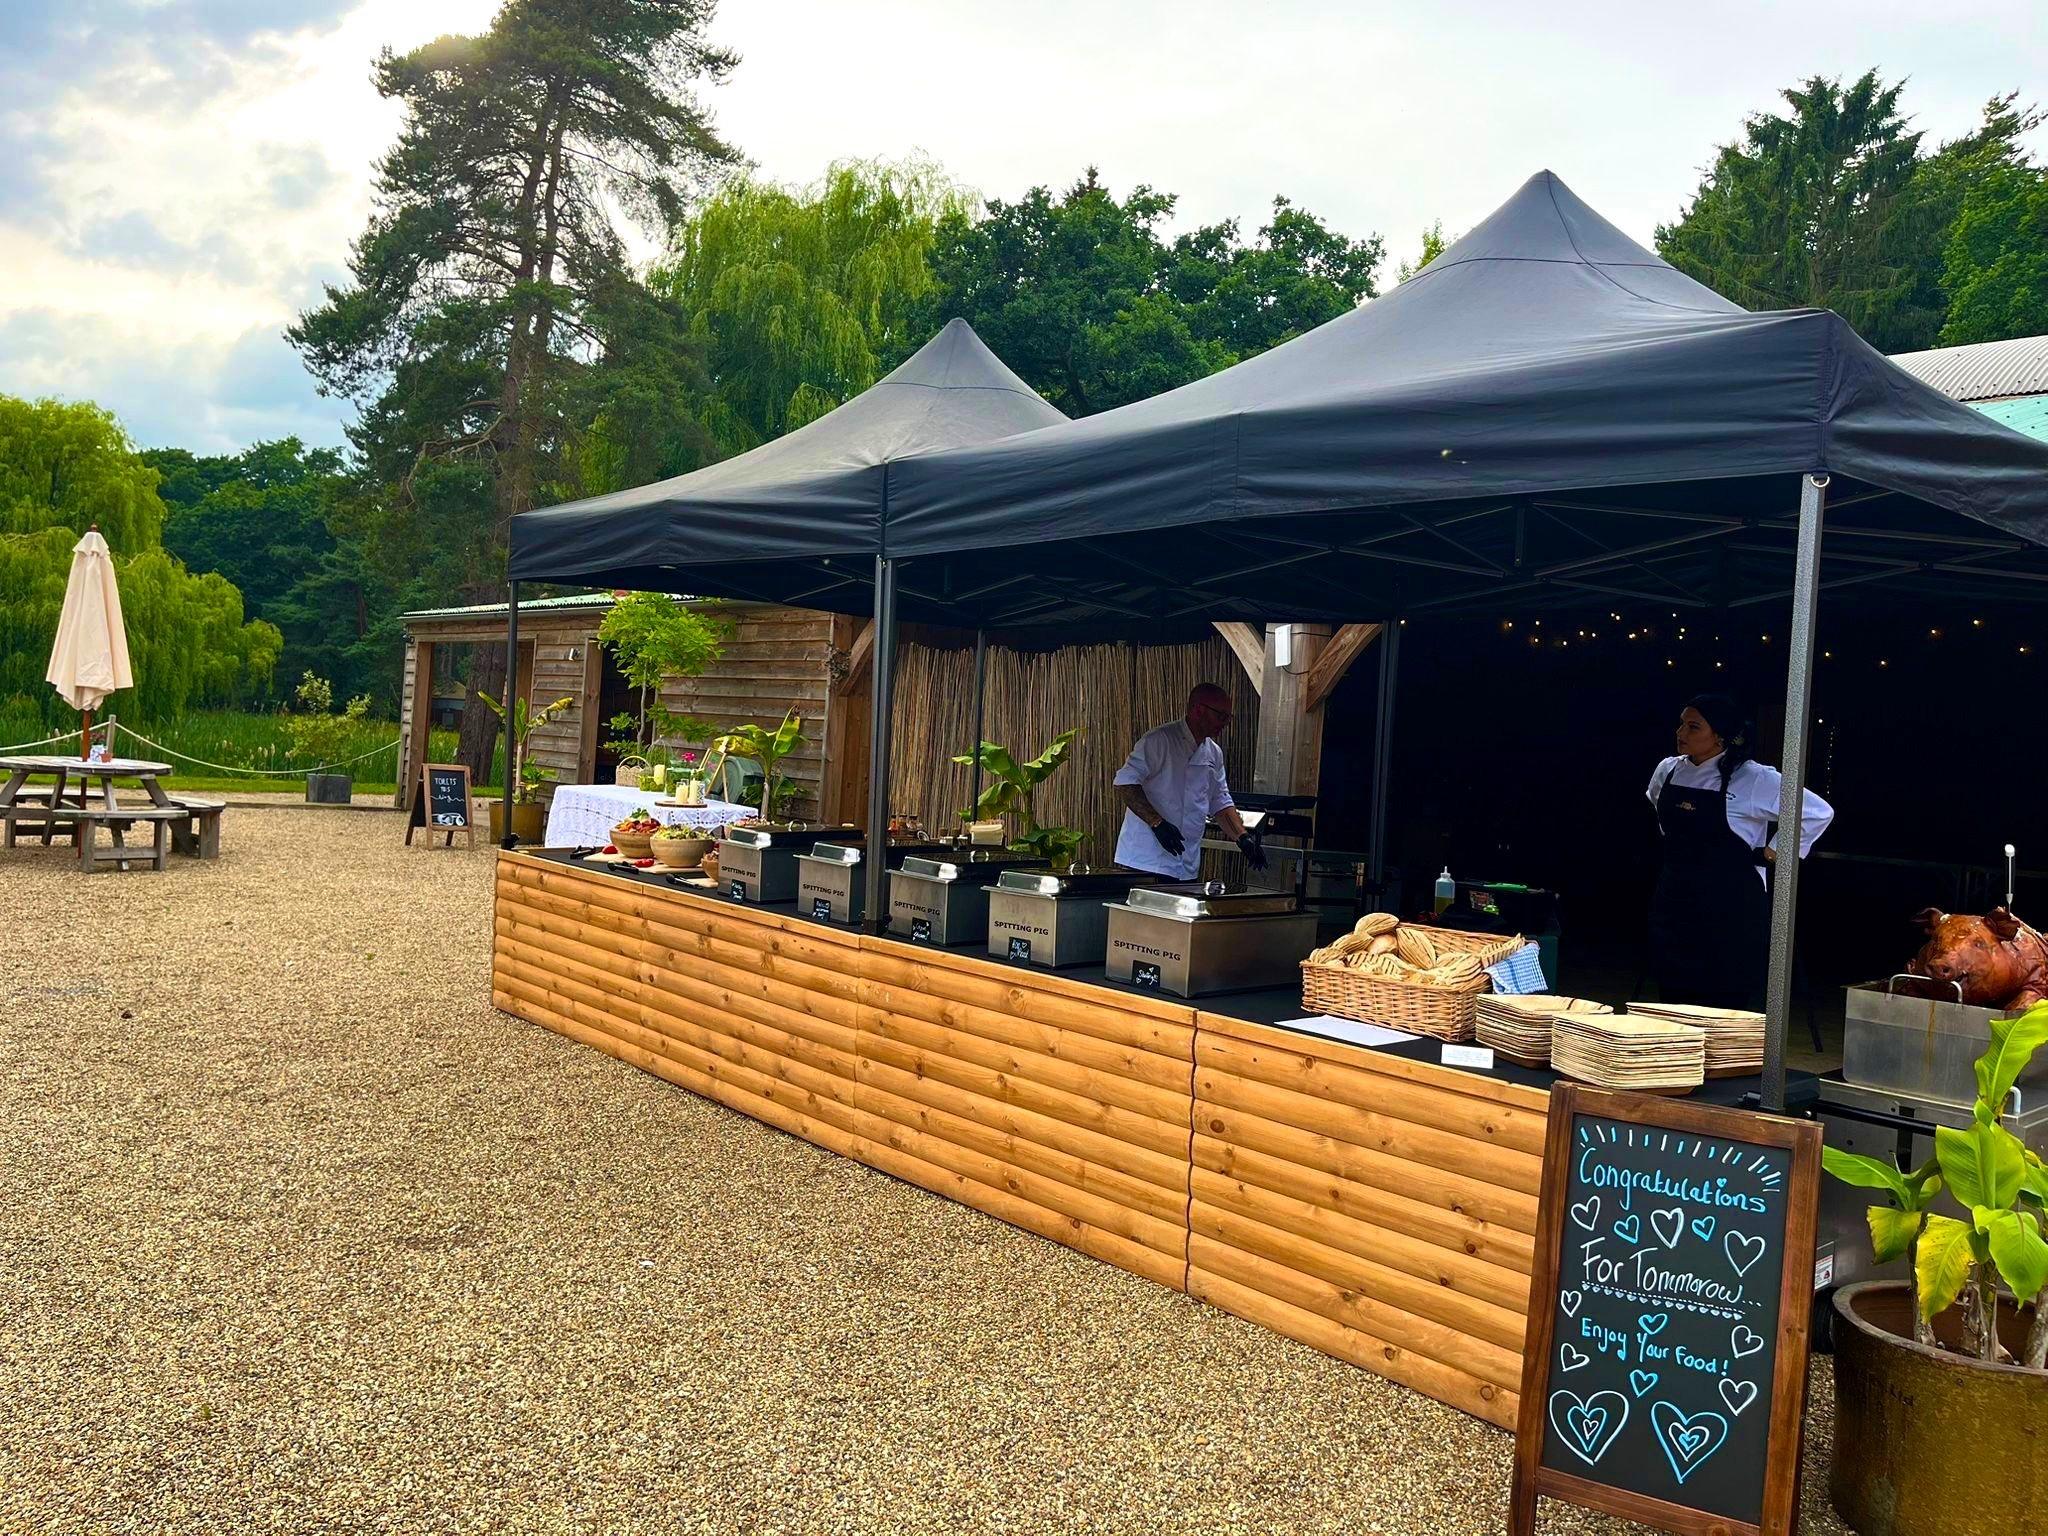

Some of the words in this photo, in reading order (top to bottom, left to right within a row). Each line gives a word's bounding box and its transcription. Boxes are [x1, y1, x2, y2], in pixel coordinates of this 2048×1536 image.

[721, 865, 745, 876] SPITTING
[802, 883, 831, 895] SPITTING
[832, 889, 844, 897] PIG
[894, 900, 926, 913] SPITTING
[927, 908, 941, 916] PIG
[994, 920, 1032, 933] SPITTING
[1033, 927, 1049, 936] PIG
[1113, 939, 1160, 956] SPITTING
[1162, 950, 1181, 961] PIG
[1578, 1147, 1768, 1214] Congratulations
[1579, 1236, 1625, 1284] For
[1581, 1317, 1628, 1361] Enjoy
